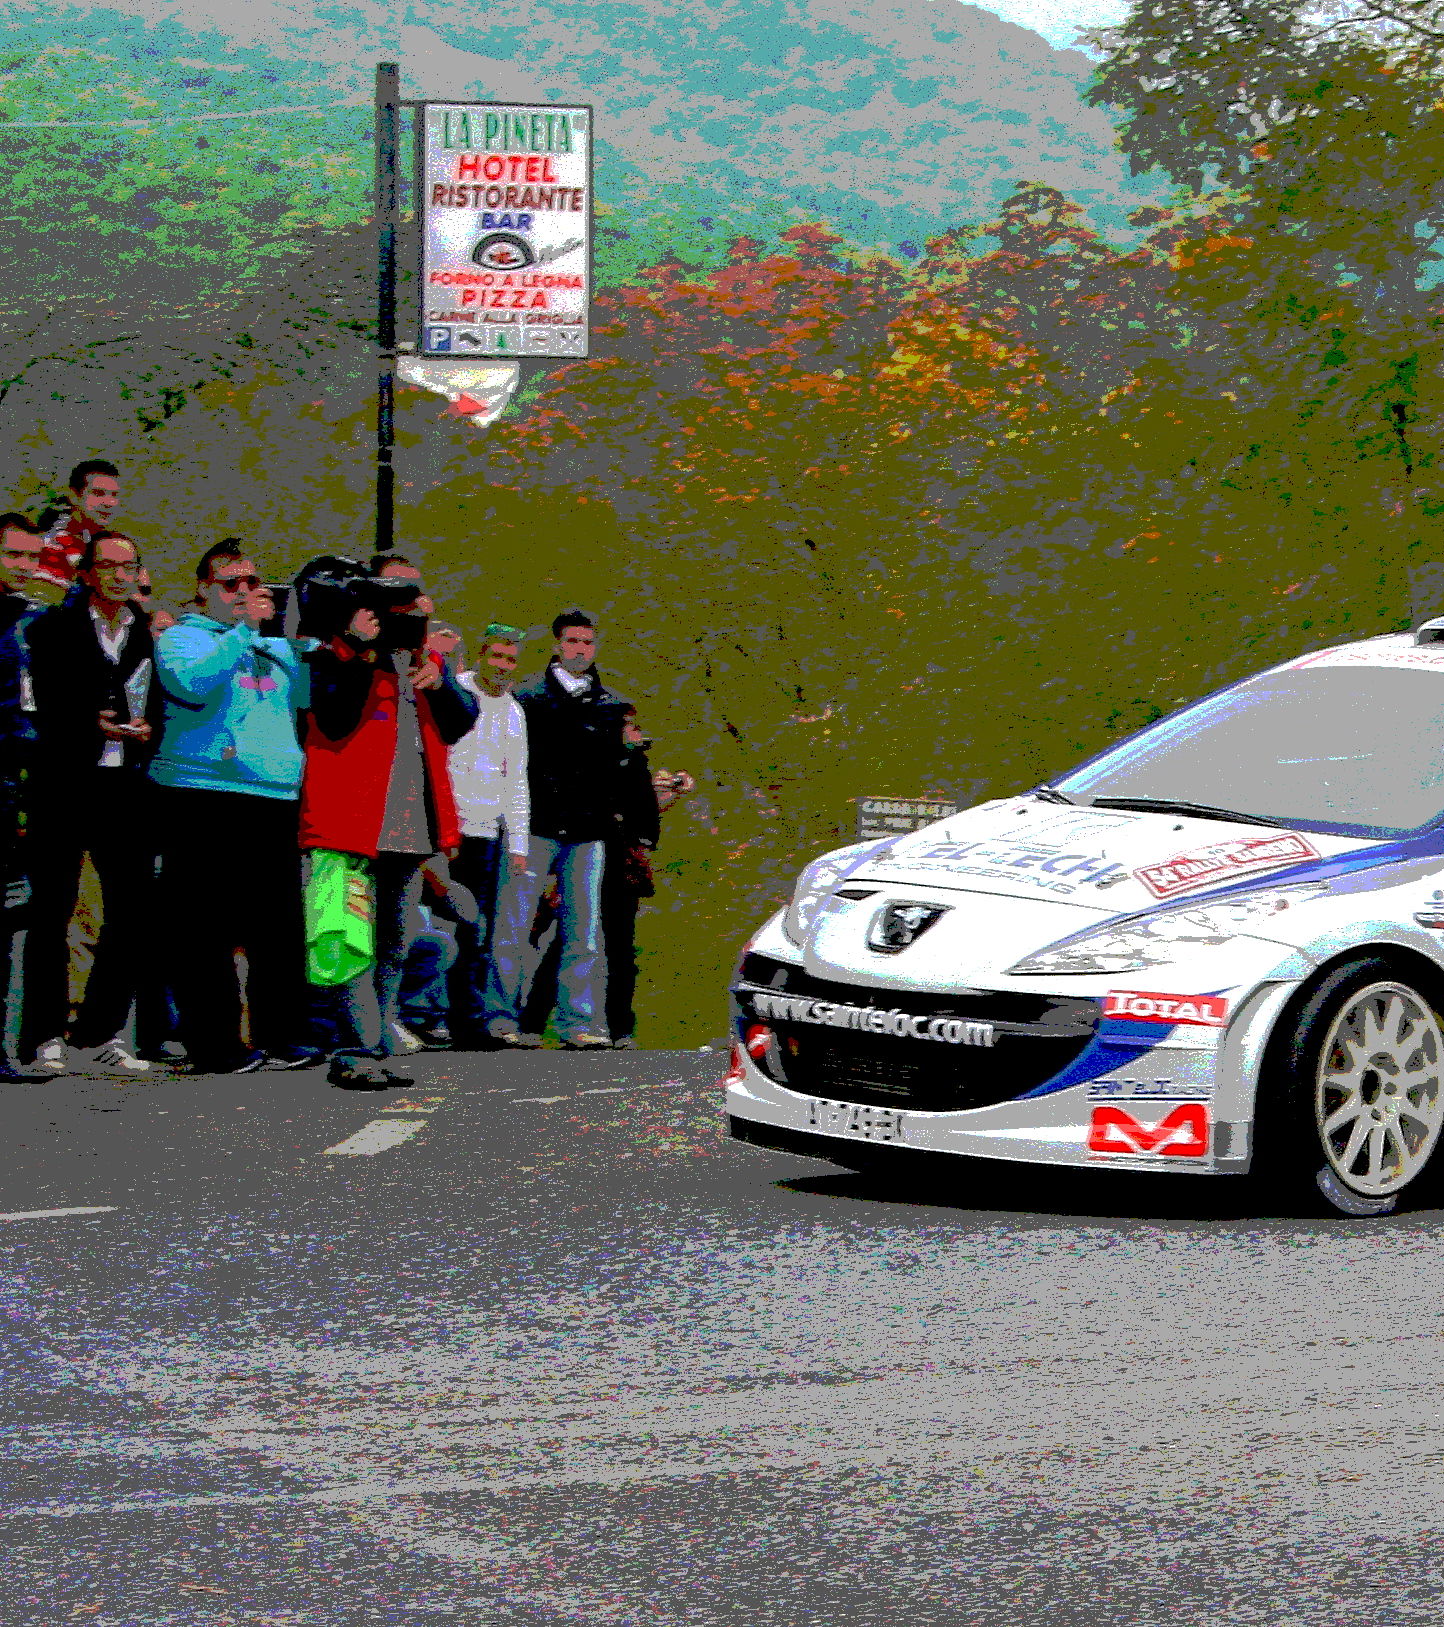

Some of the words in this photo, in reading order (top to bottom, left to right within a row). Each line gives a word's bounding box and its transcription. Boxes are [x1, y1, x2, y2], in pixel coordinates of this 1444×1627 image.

[443, 112, 471, 150] LA
[485, 112, 571, 152] PINETA
[458, 154, 558, 183] HOTEL
[431, 184, 584, 212] RISTORANTE
[480, 213, 533, 231] BAR
[502, 274, 514, 287] A
[521, 275, 583, 288] LEGNA
[462, 289, 548, 309] PIZZA
[1104, 991, 1222, 1023] TOTAL
